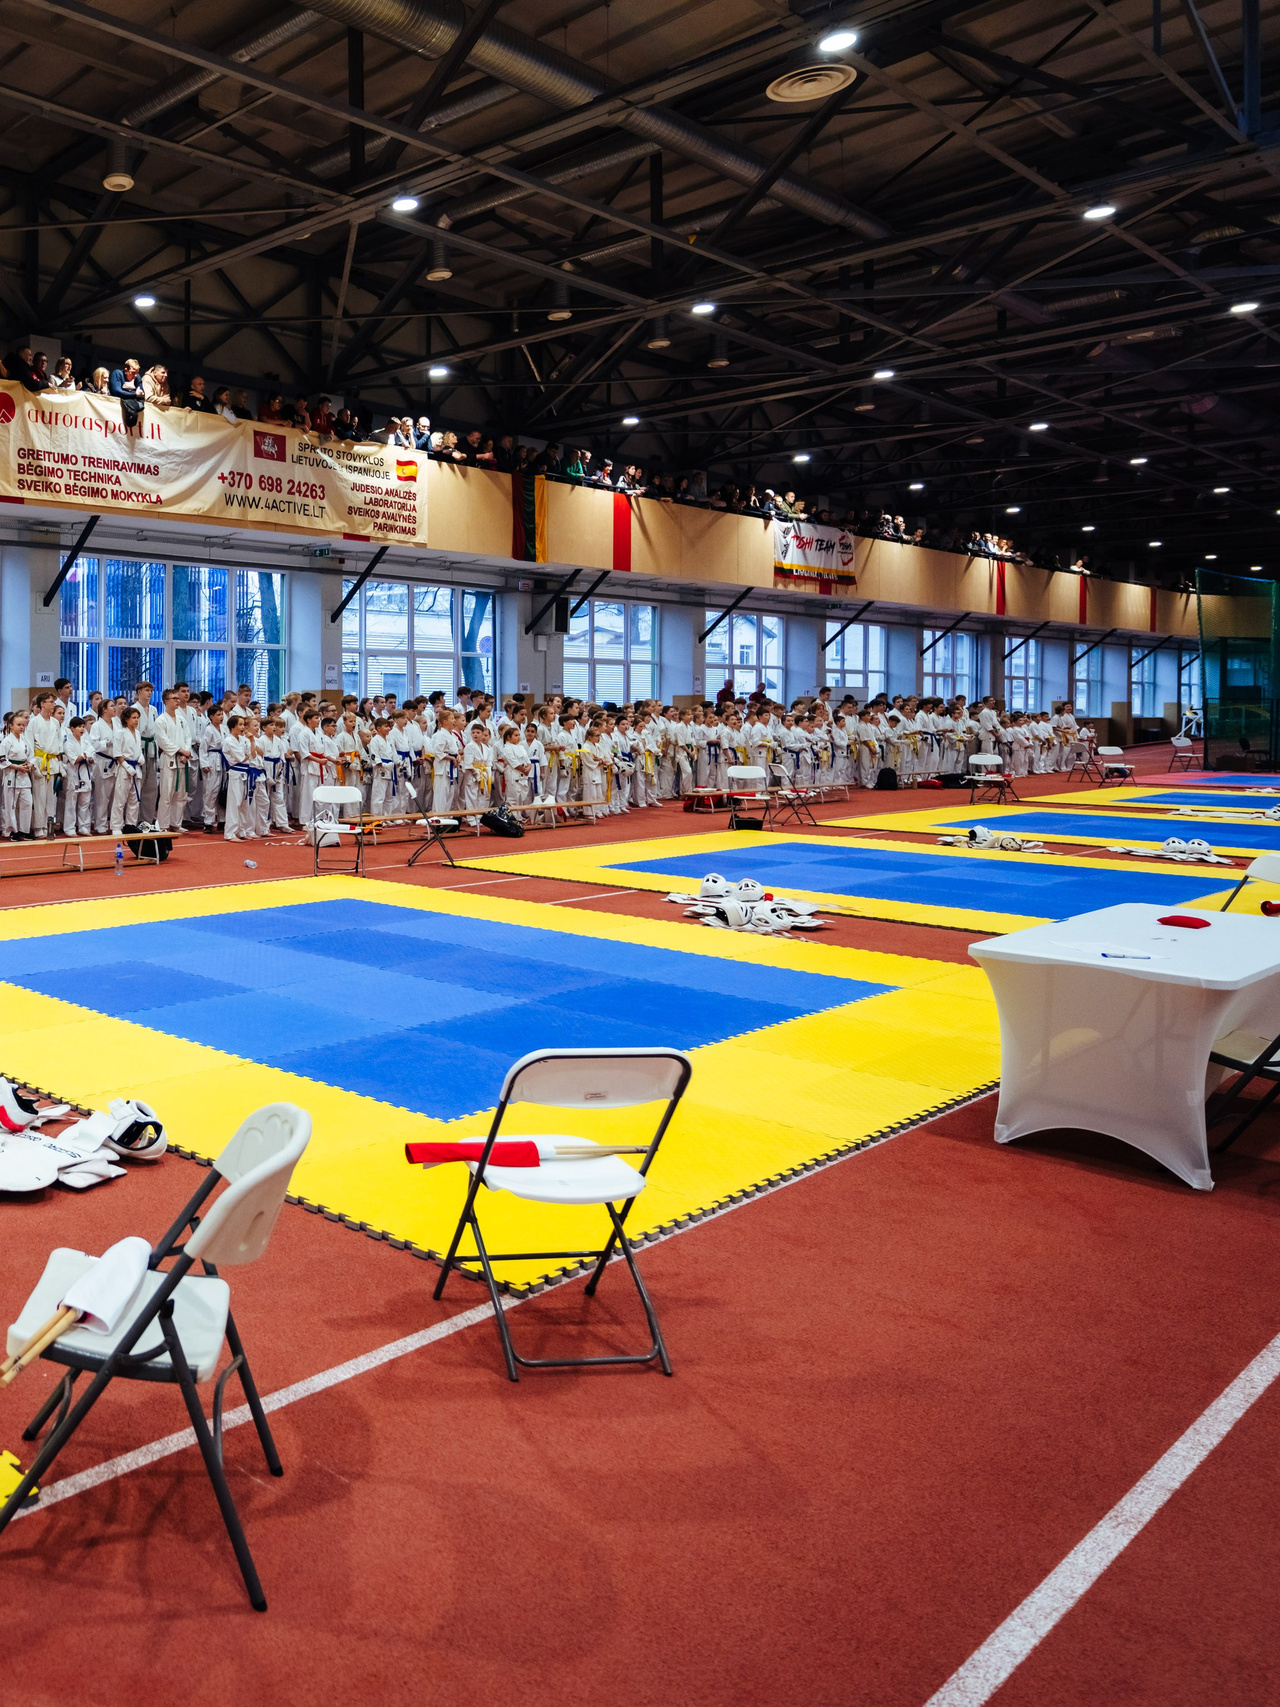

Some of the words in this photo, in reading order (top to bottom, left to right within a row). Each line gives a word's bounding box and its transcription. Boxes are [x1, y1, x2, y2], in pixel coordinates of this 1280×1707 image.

[27, 408, 163, 440] aurorasport.lt
[17, 447, 78, 466] GREITUMO
[81, 455, 160, 476] TRENIRAVIMAS
[336, 450, 385, 467] STOVYKLOS
[17, 461, 64, 479] BĖGIMO
[66, 468, 122, 486] TECHNIKA
[17, 478, 62, 494] SVEIKO
[64, 483, 109, 500] BĖGIMO
[111, 489, 163, 505] MOKYKLA
[217, 470, 253, 490] +370
[258, 476, 283, 494] 698
[286, 478, 326, 501] 24263
[350, 482, 383, 496] JUDESIO
[384, 487, 417, 501] ANALIZĖS
[224, 492, 326, 519] WWW.4ACTIVE.LT
[347, 505, 380, 520] SVEIKOS
[363, 496, 417, 513] LABORATORIJA
[373, 521, 417, 536] PARINKIMAS
[815, 538, 836, 556] TEAM
